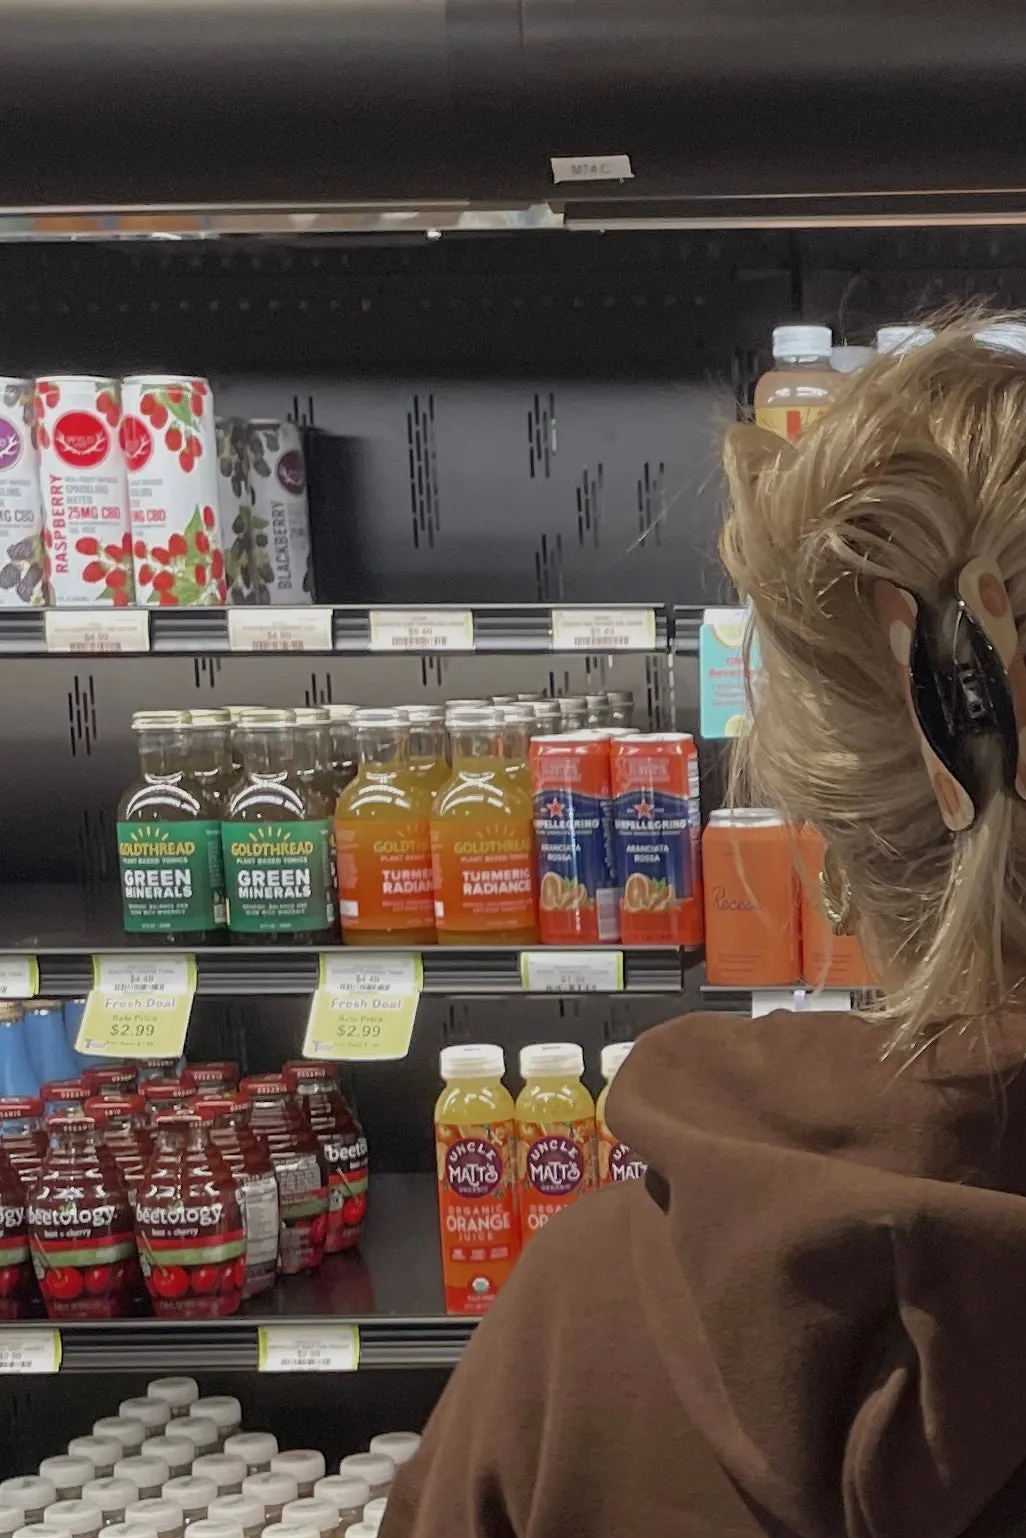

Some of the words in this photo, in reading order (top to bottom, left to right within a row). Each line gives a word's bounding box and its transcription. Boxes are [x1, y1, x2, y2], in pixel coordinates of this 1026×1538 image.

[67, 506, 99, 520] 25MG
[101, 506, 121, 520] CBD
[49, 474, 69, 574] RASPBERRY
[270, 499, 293, 589] BLACKBERRY
[231, 840, 314, 857] GOLDTHREAD
[124, 868, 192, 887] GREEN
[237, 868, 311, 888] GREEN
[462, 868, 530, 882] TURMERIC
[125, 886, 193, 899] MINERALS
[238, 886, 312, 899] MINERALS
[463, 881, 531, 896] RADIANCE
[109, 1023, 155, 1037] $2.99
[336, 1024, 381, 1038] $2.99
[449, 1141, 497, 1162] UNCLE
[530, 1139, 579, 1161] UNCLE
[28, 1202, 116, 1227] beetology
[135, 1202, 222, 1227] beetology
[448, 1204, 503, 1215] ORGANIC
[446, 1212, 511, 1232] ORANGE
[459, 1231, 494, 1242] JUICE
